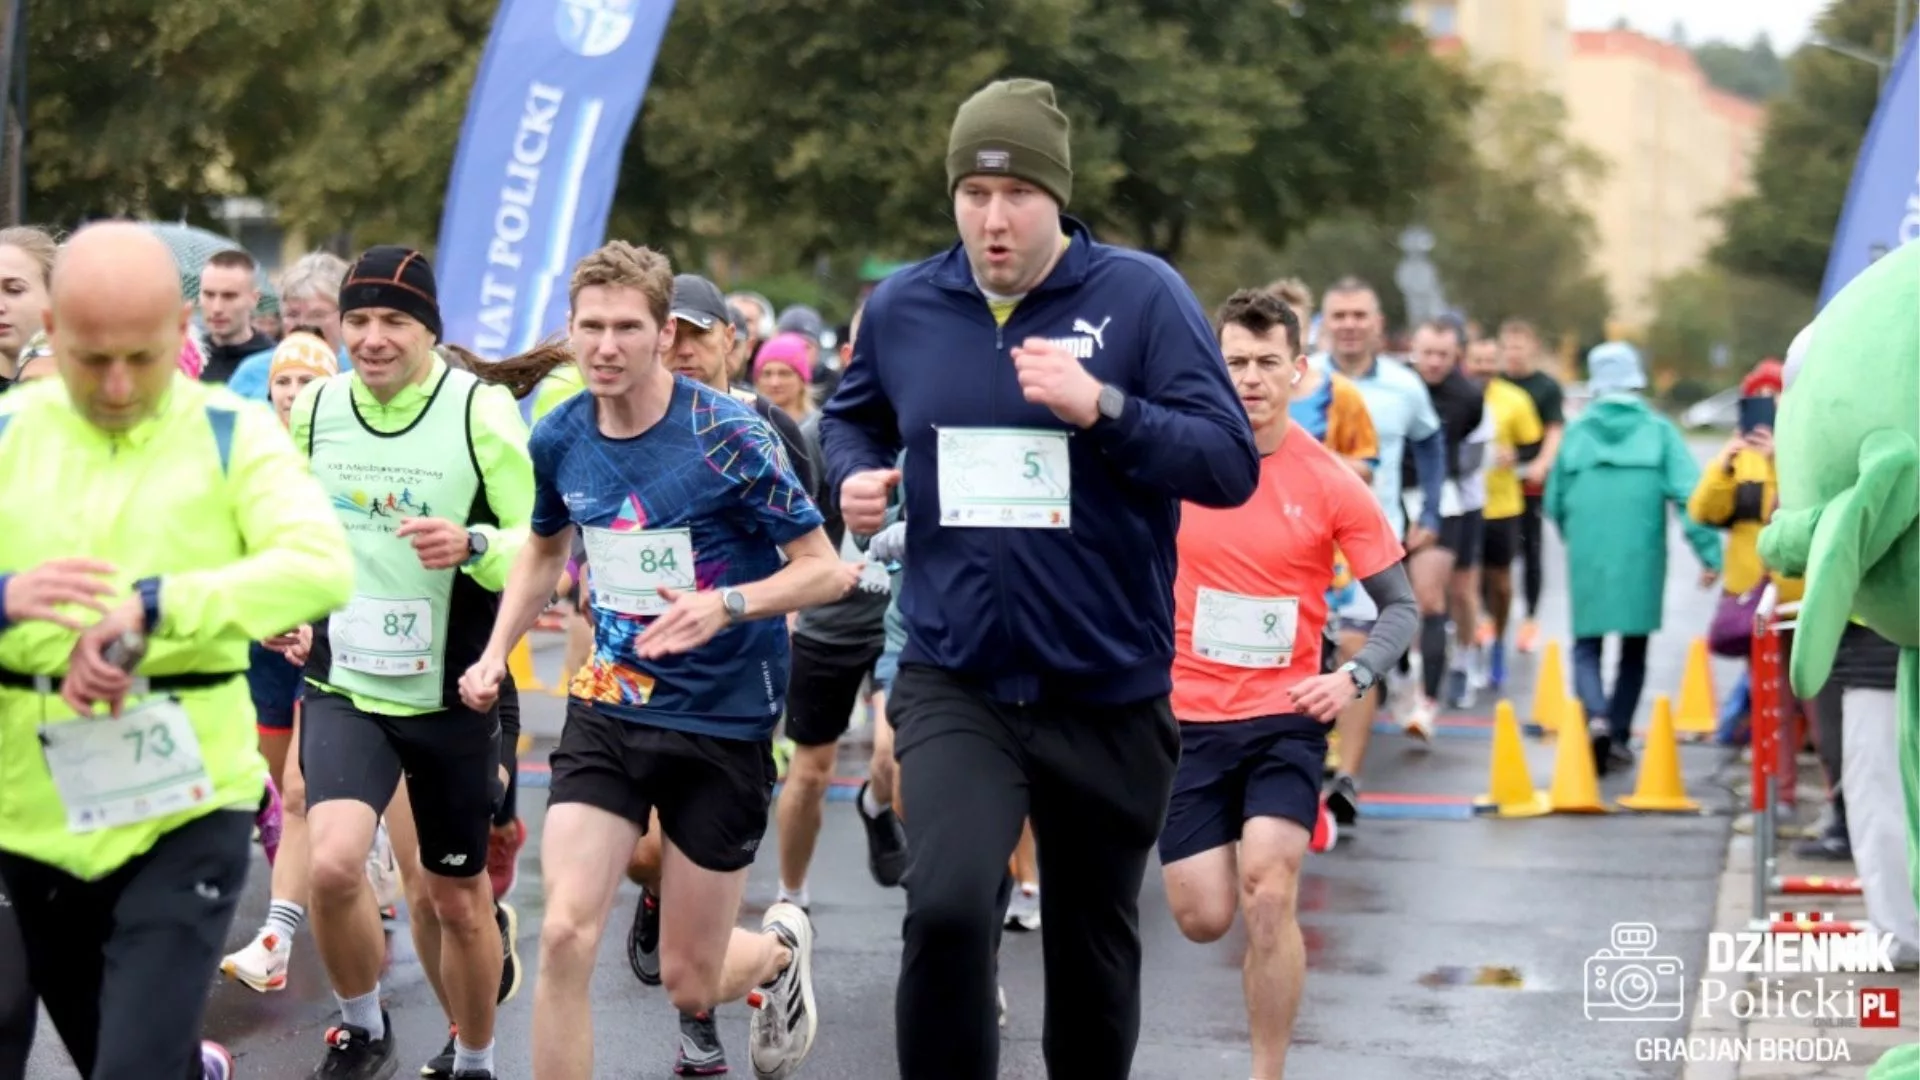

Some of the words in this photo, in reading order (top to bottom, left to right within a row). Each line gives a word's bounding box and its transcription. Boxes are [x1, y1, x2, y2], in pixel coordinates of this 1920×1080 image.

[489, 81, 565, 271] POLICKI
[1022, 451, 1041, 479] 5
[640, 547, 677, 573] 84
[383, 613, 418, 636] 87
[1263, 613, 1278, 634] 9
[122, 723, 175, 763] 73
